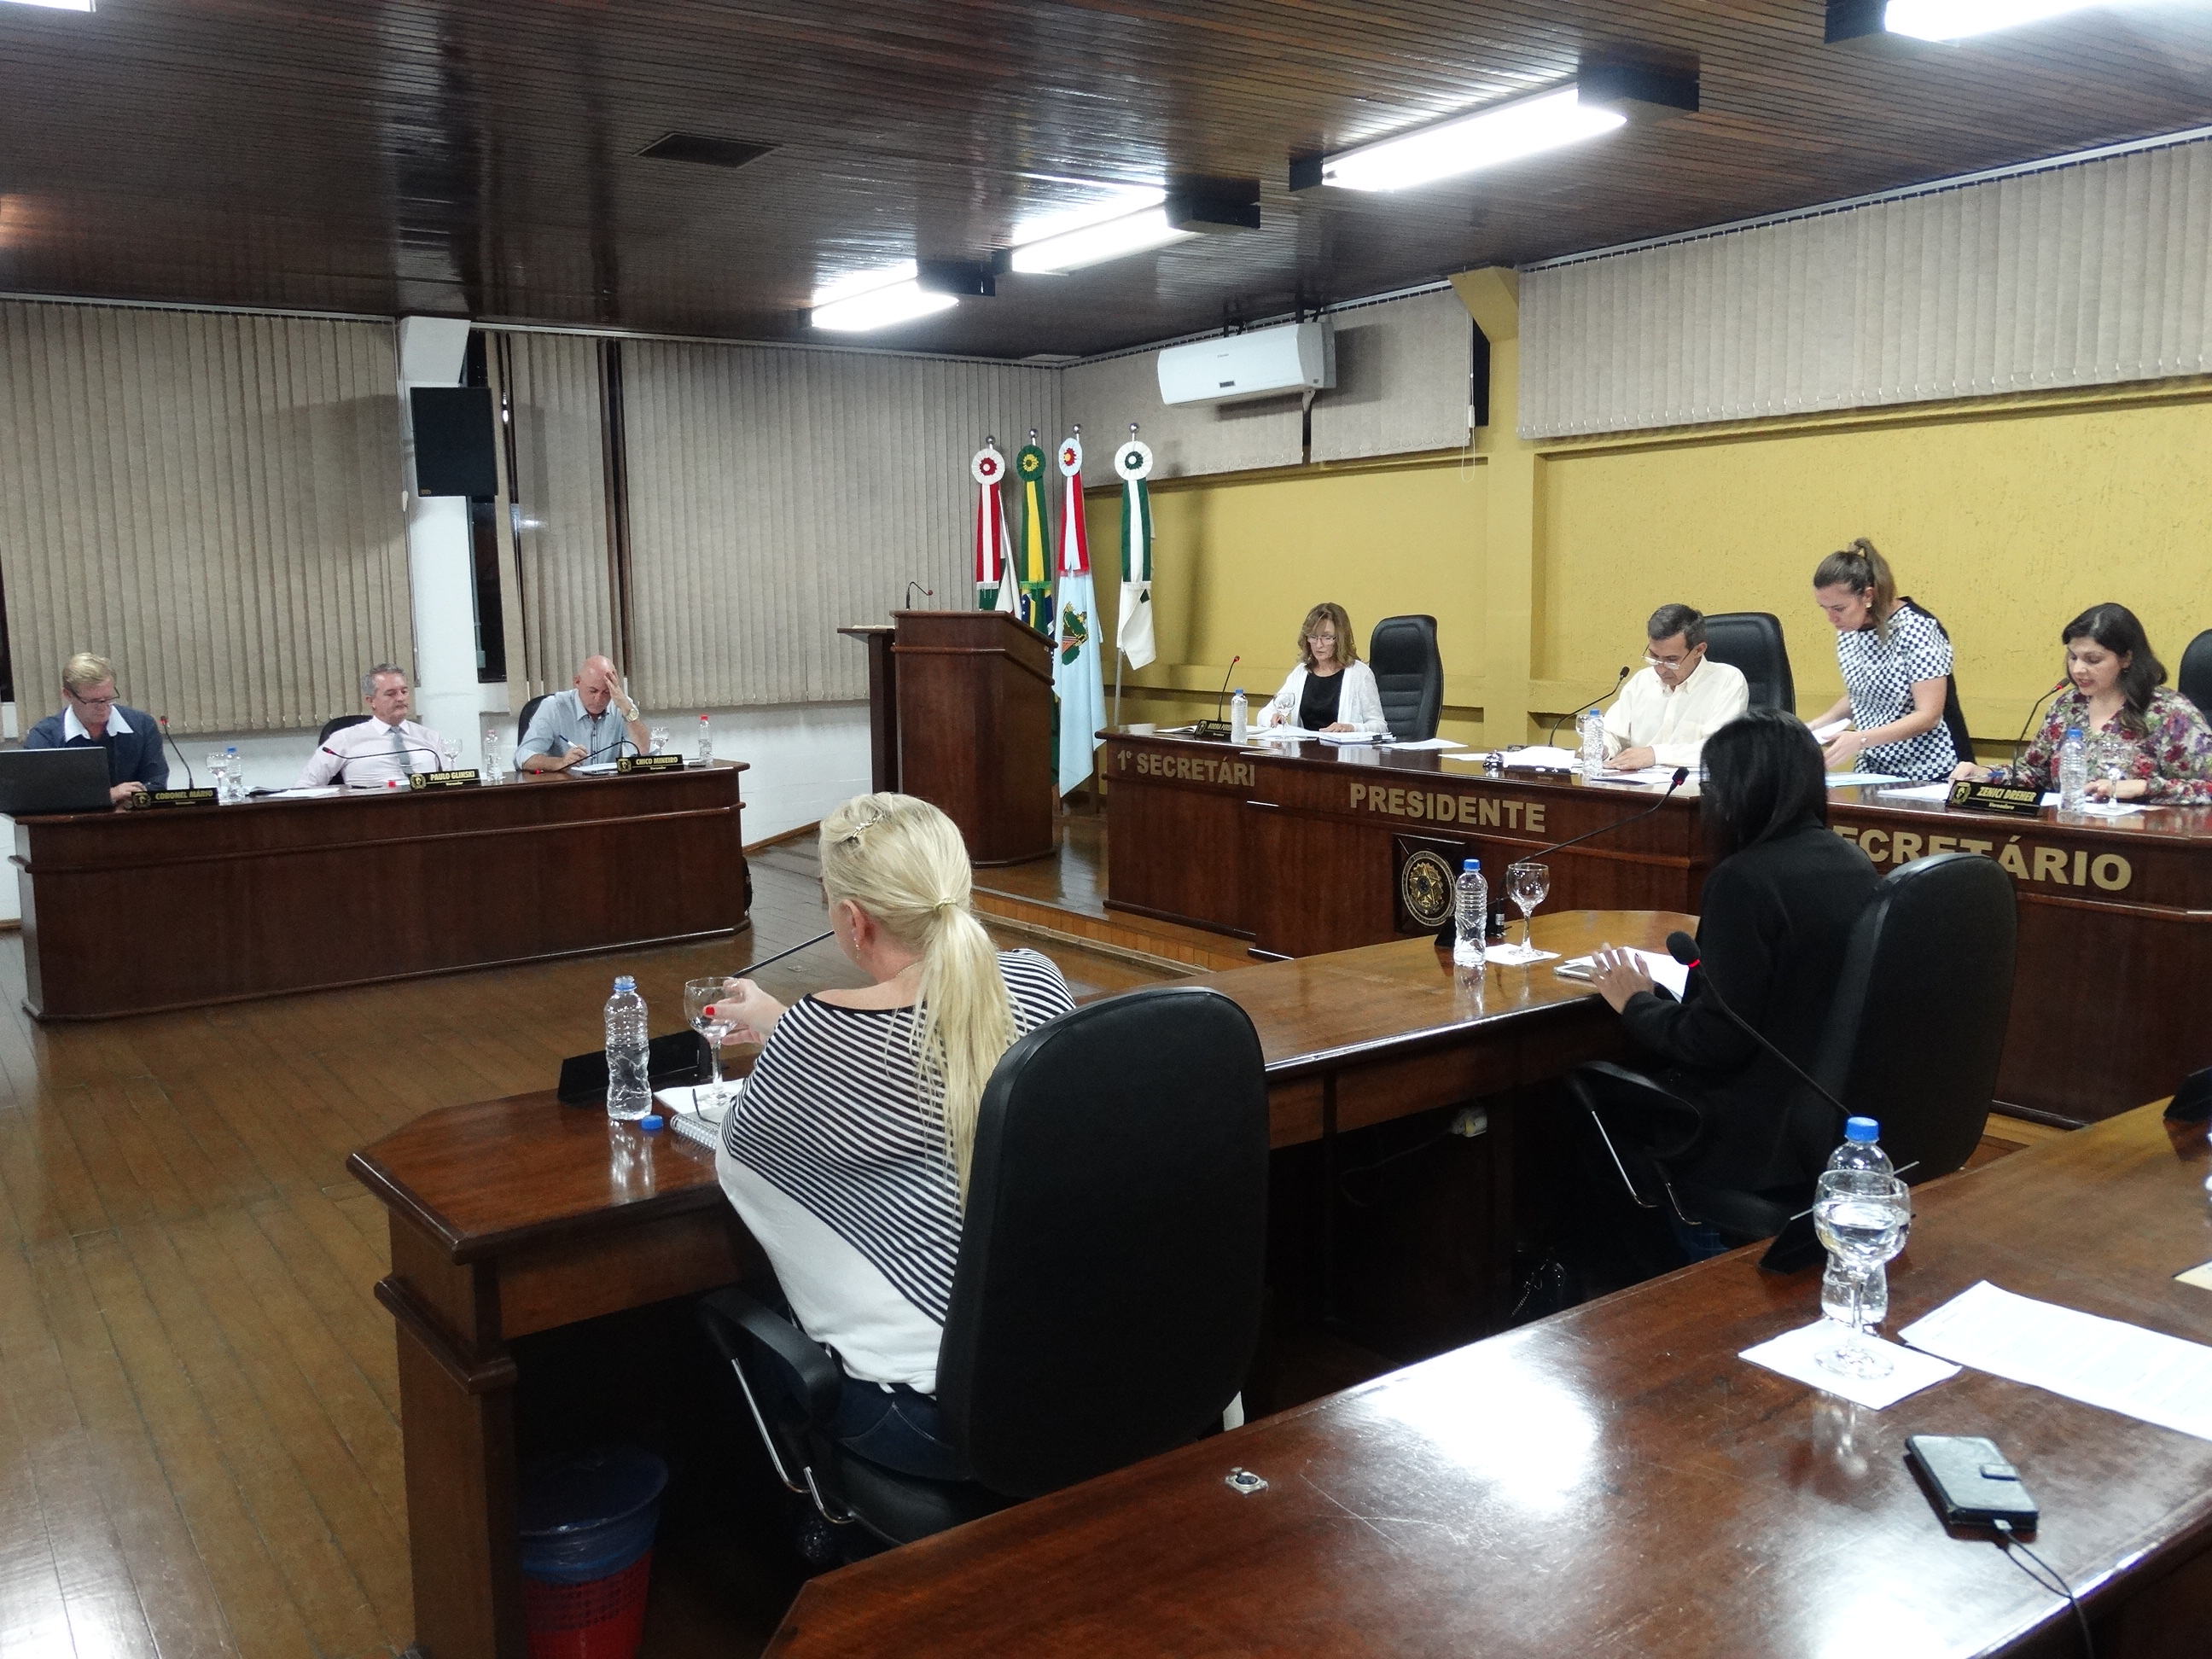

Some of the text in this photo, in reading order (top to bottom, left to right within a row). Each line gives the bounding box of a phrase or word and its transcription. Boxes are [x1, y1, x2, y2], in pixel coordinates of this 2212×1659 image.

[1137, 753, 1255, 787] SECRETÁRI
[1350, 783, 1545, 833] PRESIDENTE
[1832, 825, 2133, 892] ECRETÁRIO
